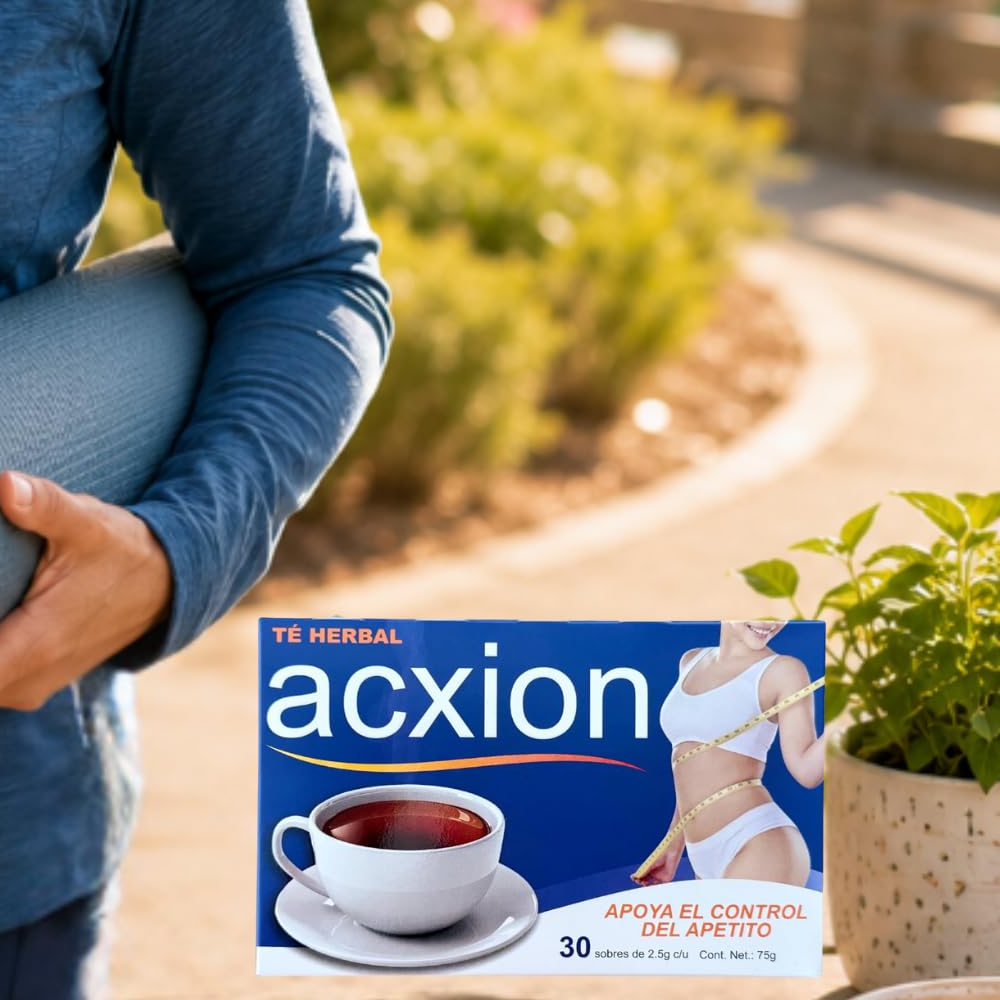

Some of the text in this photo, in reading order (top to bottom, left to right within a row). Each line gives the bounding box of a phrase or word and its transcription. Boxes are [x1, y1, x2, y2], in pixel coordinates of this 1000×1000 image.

[271, 624, 403, 645] TÉ HERBAL
[266, 641, 649, 740] acxion
[604, 903, 808, 920] APOYA EL CONTROL
[641, 922, 772, 938] DEL APETITO
[559, 936, 591, 958] 30
[594, 949, 629, 959] sobres
[632, 949, 645, 959] de
[647, 949, 670, 961] 2.5g
[673, 949, 689, 960] c/u
[699, 950, 727, 960] Cont.
[757, 950, 776, 962] 75g
